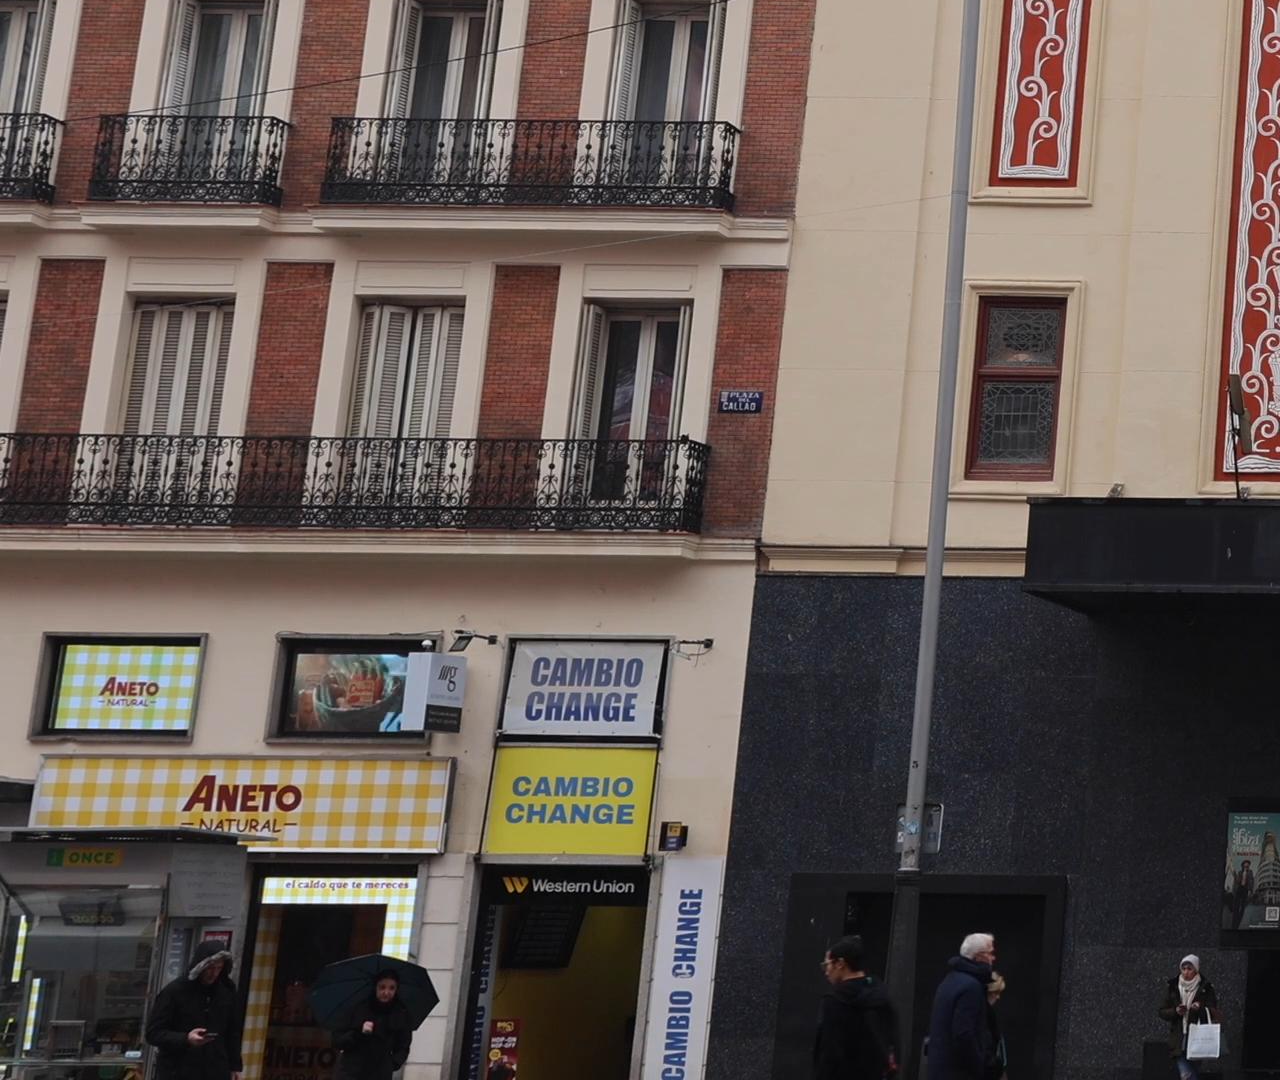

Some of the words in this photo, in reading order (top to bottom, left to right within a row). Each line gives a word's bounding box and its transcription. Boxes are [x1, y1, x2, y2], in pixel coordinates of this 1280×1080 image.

[722, 402, 756, 411] CALLAO
[530, 657, 644, 688] CAMBIO
[99, 676, 160, 697] ANETO
[106, 698, 149, 707] NATURAL
[524, 691, 638, 722] CHANGE
[182, 775, 302, 813] ANETO
[512, 776, 634, 797] CAMBIO
[505, 803, 635, 825] CHANGE
[200, 818, 282, 834] NATURAL
[68, 851, 114, 864] ONCE
[285, 880, 295, 889] el
[297, 880, 327, 889] caldo
[329, 881, 348, 891] que
[351, 881, 362, 889] te
[532, 879, 592, 894] Western
[593, 879, 635, 894] Union
[671, 889, 704, 979] CHANGE
[661, 990, 693, 1080] CAMBIO
